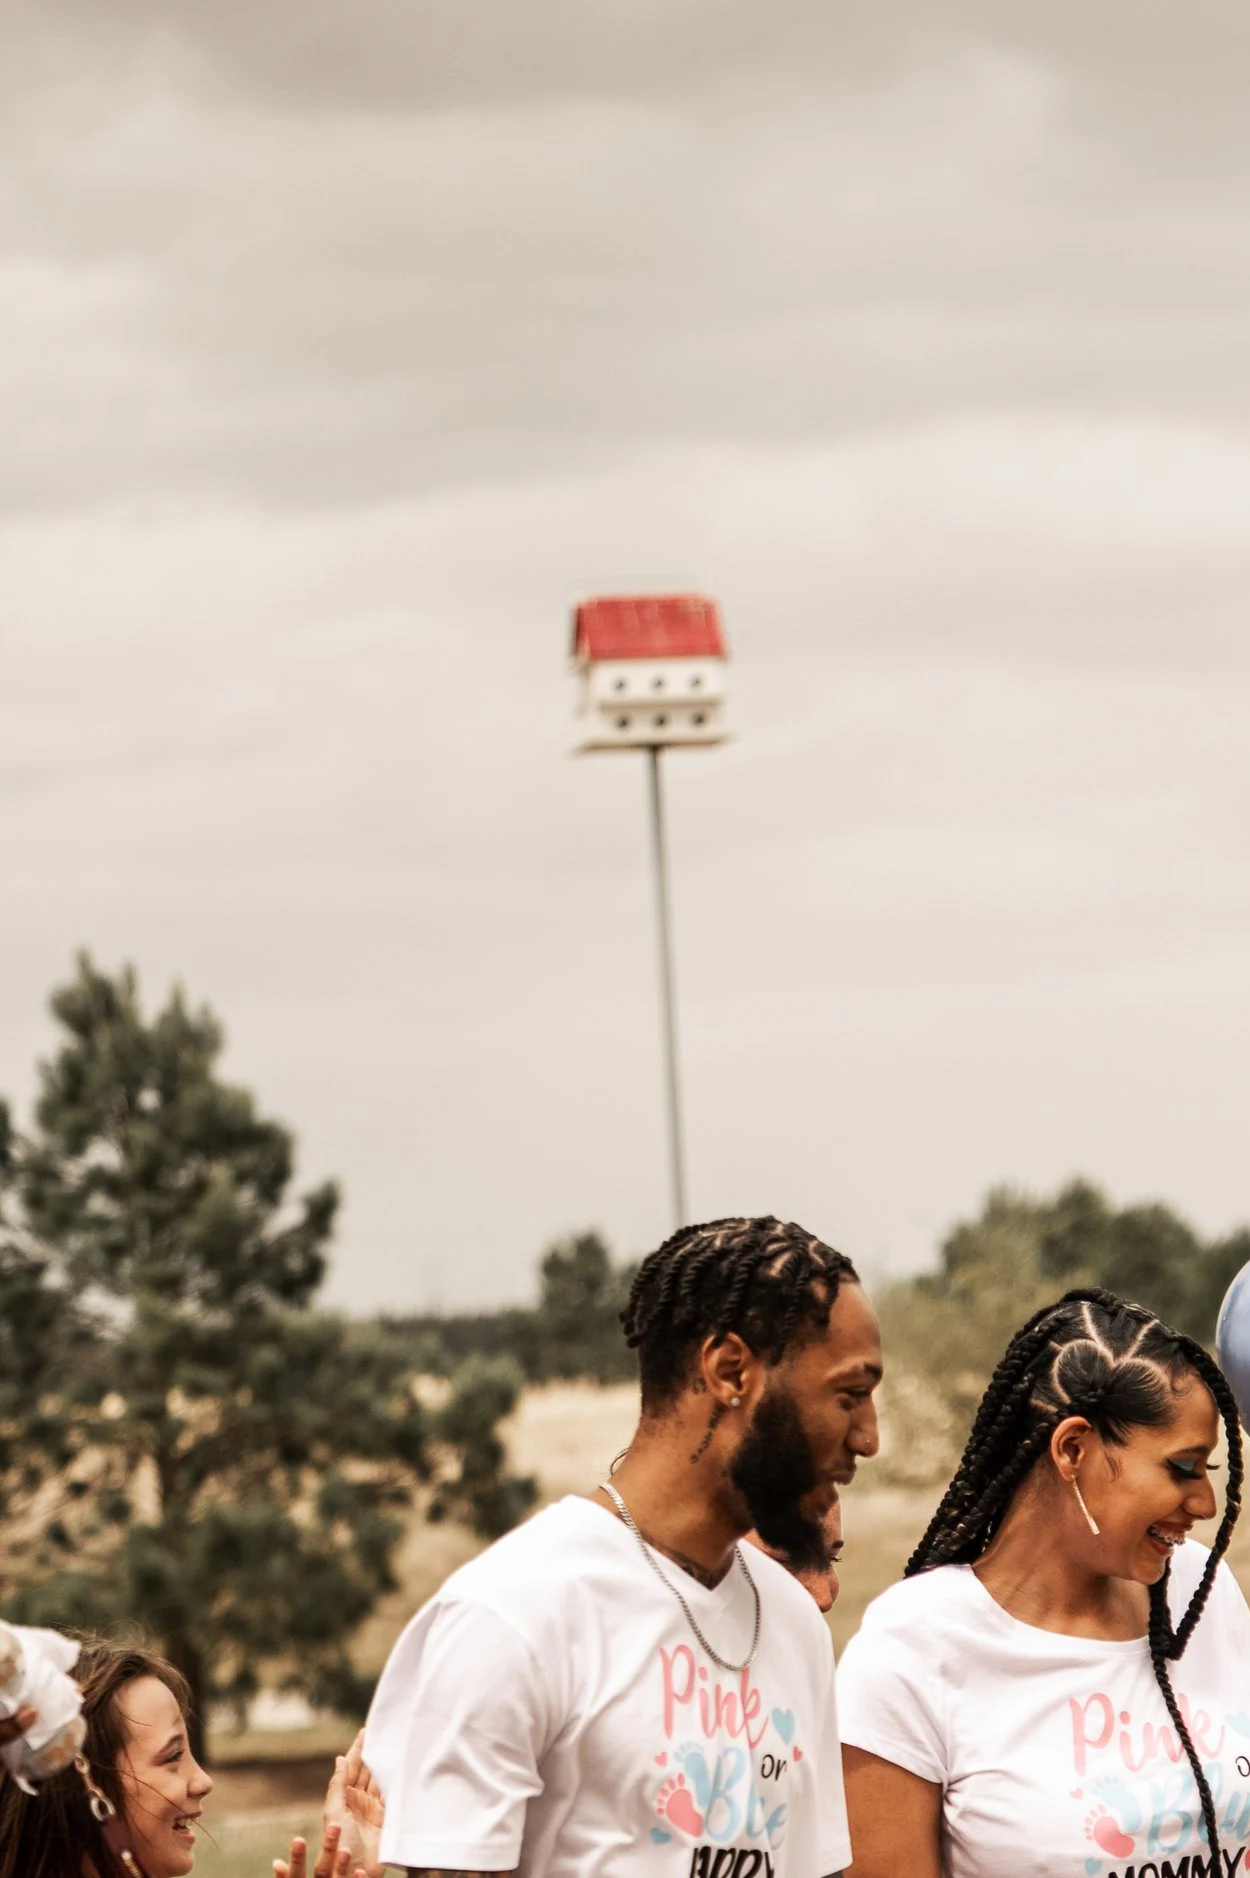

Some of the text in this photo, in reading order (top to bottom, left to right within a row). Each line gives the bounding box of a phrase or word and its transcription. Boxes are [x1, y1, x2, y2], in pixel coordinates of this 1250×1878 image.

[660, 1644, 769, 1750] Pink
[1069, 1692, 1226, 1777] Pink
[761, 1754, 787, 1782] or
